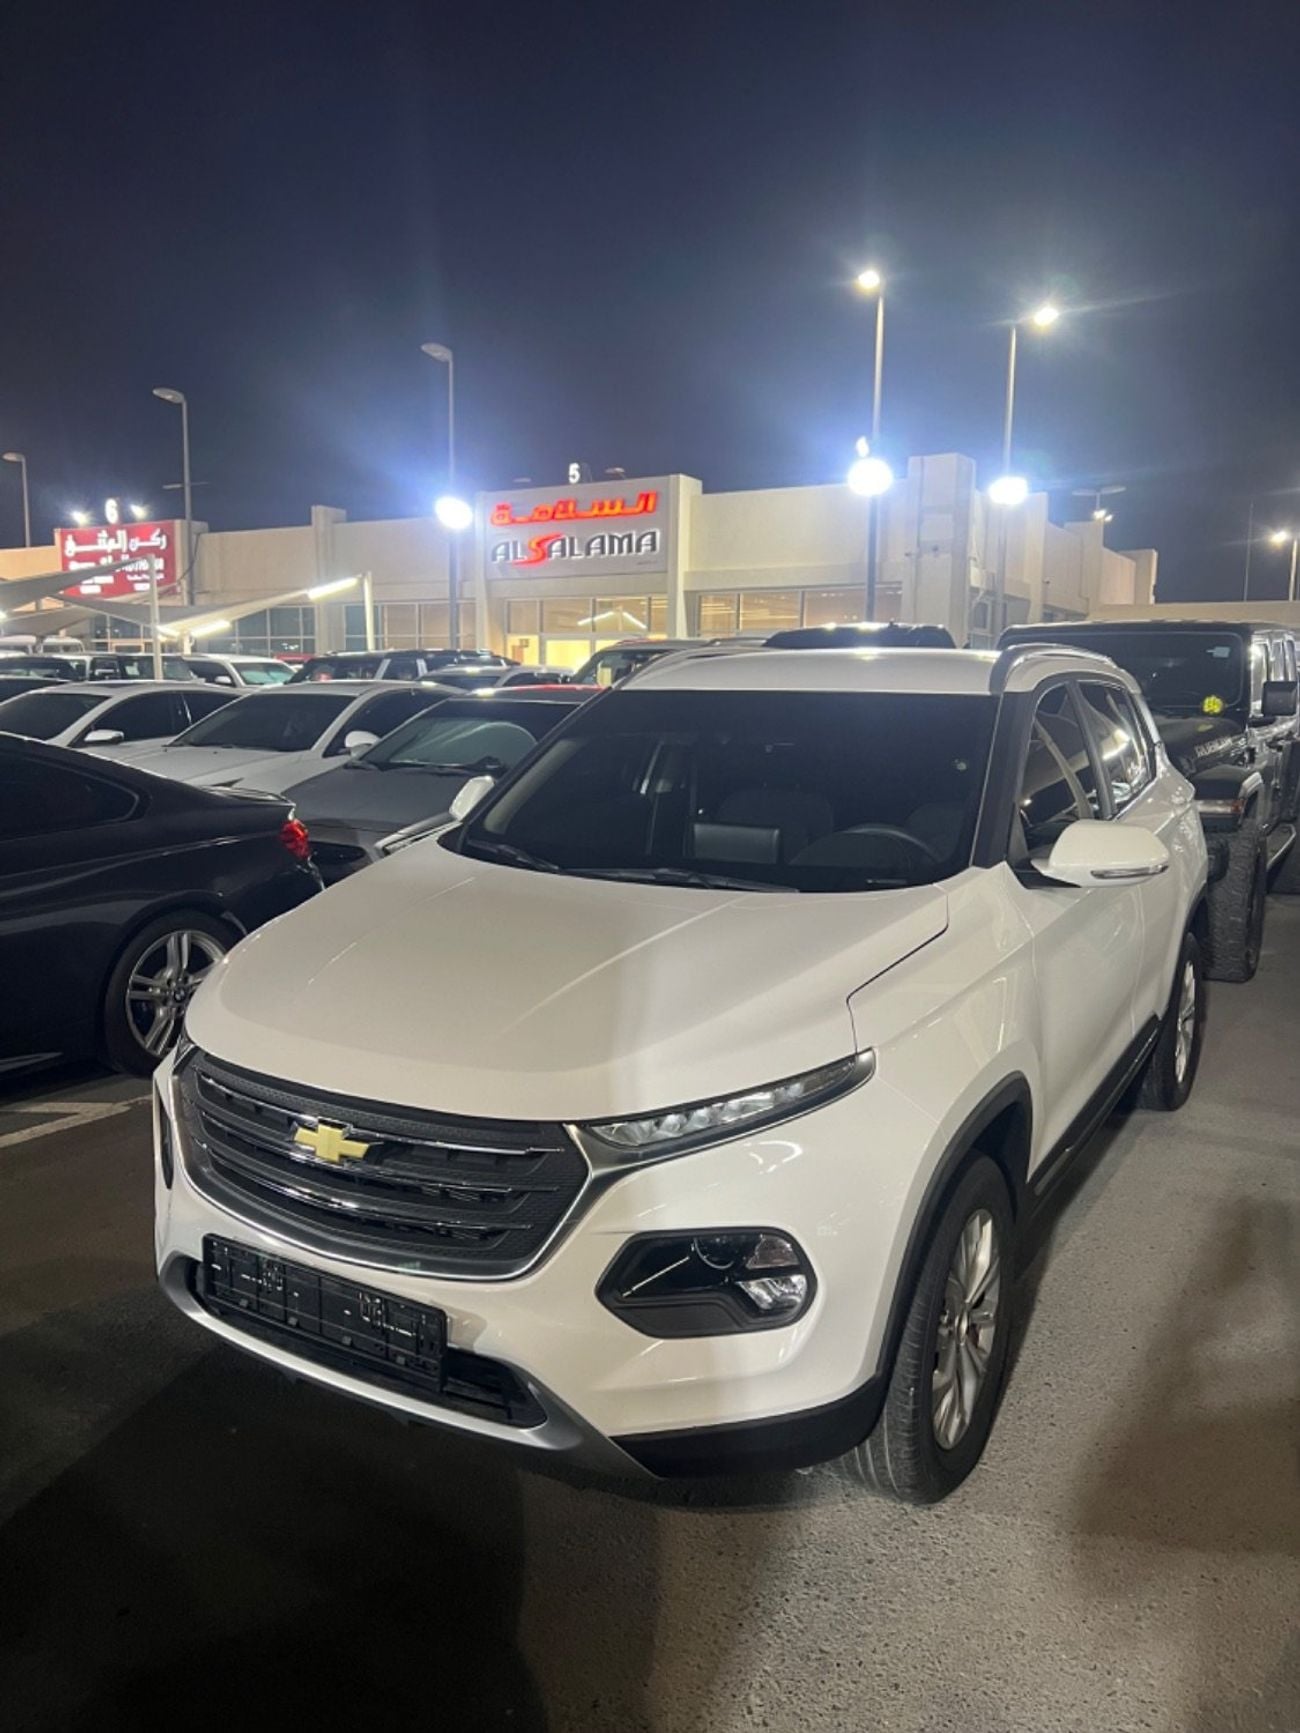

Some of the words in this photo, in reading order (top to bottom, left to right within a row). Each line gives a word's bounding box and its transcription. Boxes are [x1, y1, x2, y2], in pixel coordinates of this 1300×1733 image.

[569, 463, 580, 484] 5
[105, 498, 119, 524] 6
[491, 491, 658, 526] السلامة
[129, 528, 167, 551] ركن
